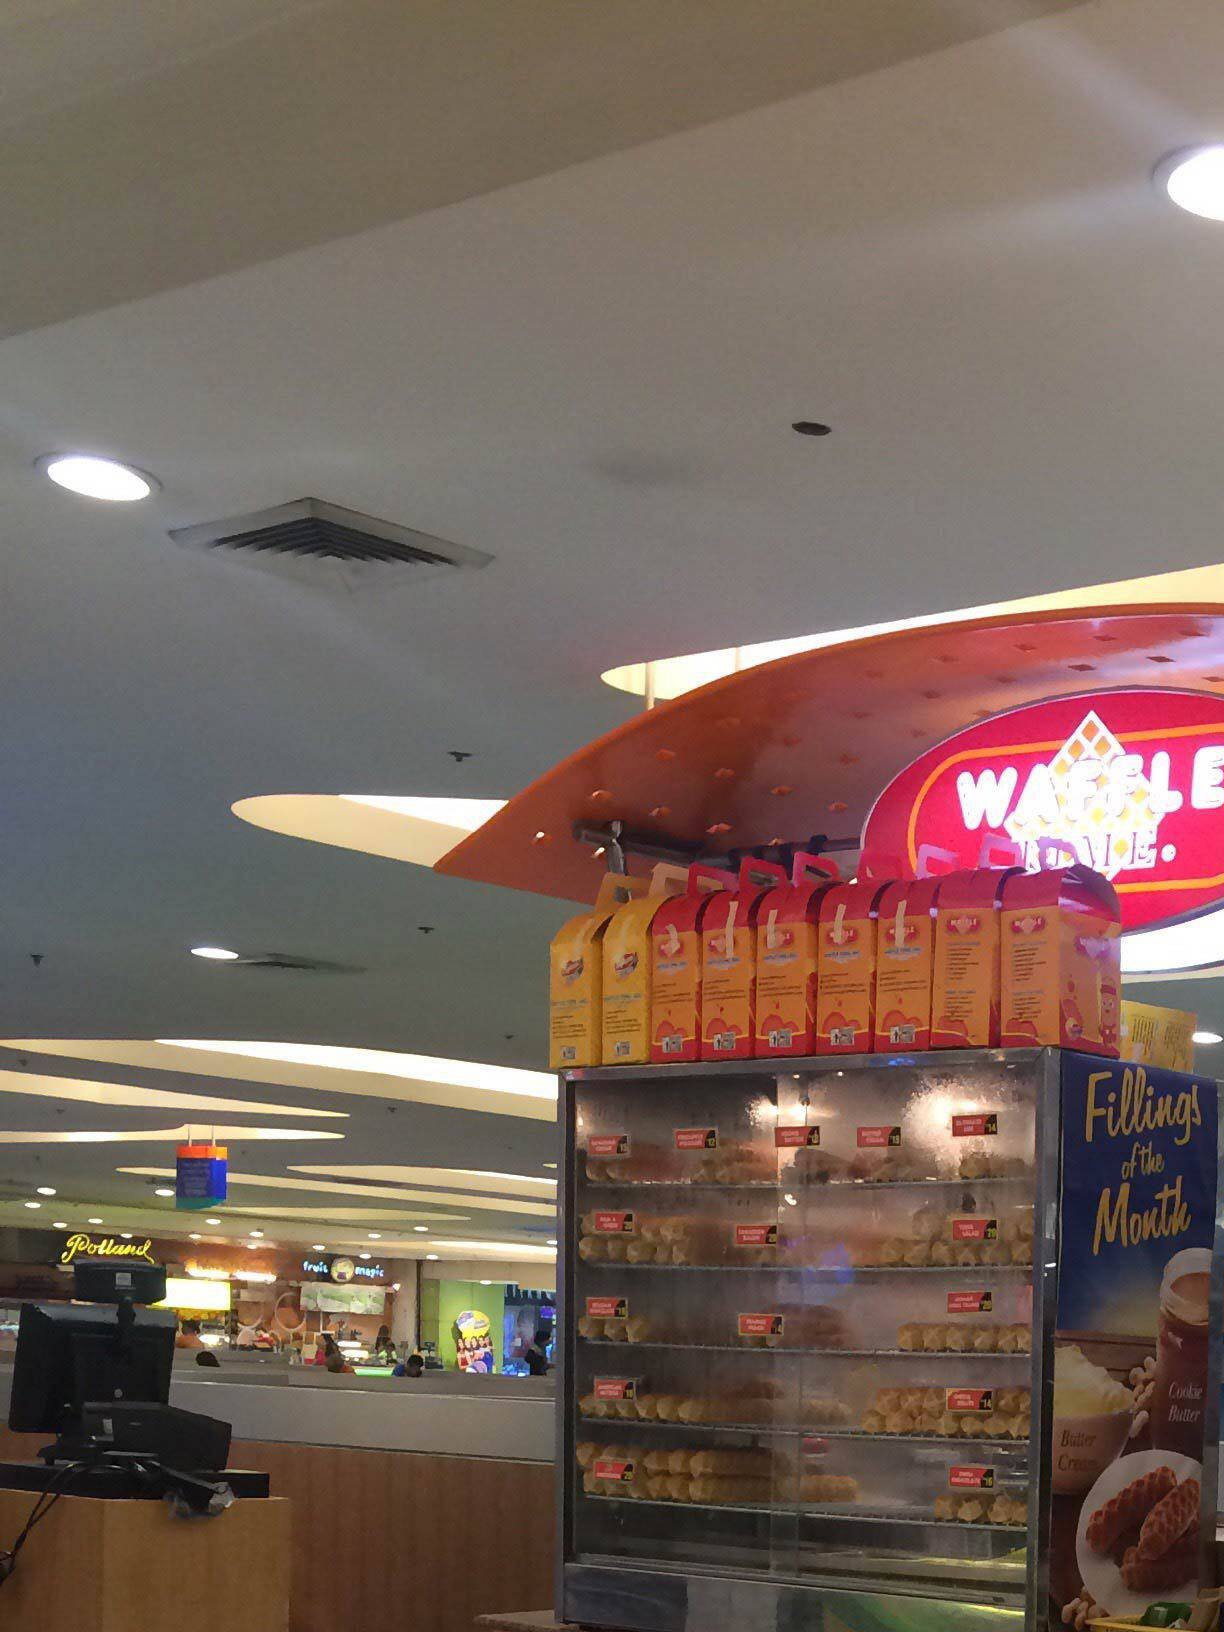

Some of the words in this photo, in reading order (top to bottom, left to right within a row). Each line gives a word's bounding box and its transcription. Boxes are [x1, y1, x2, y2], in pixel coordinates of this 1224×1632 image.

[1085, 1067, 1202, 1146] Fillings
[1122, 1141, 1137, 1180] of
[1138, 1141, 1165, 1176] the
[1093, 1175, 1192, 1256] Month
[303, 1261, 328, 1273] fruit
[355, 1264, 384, 1279] magic
[1168, 1381, 1203, 1401] Cookie
[1168, 1404, 1201, 1423] Butter
[1060, 1429, 1097, 1449] Butter
